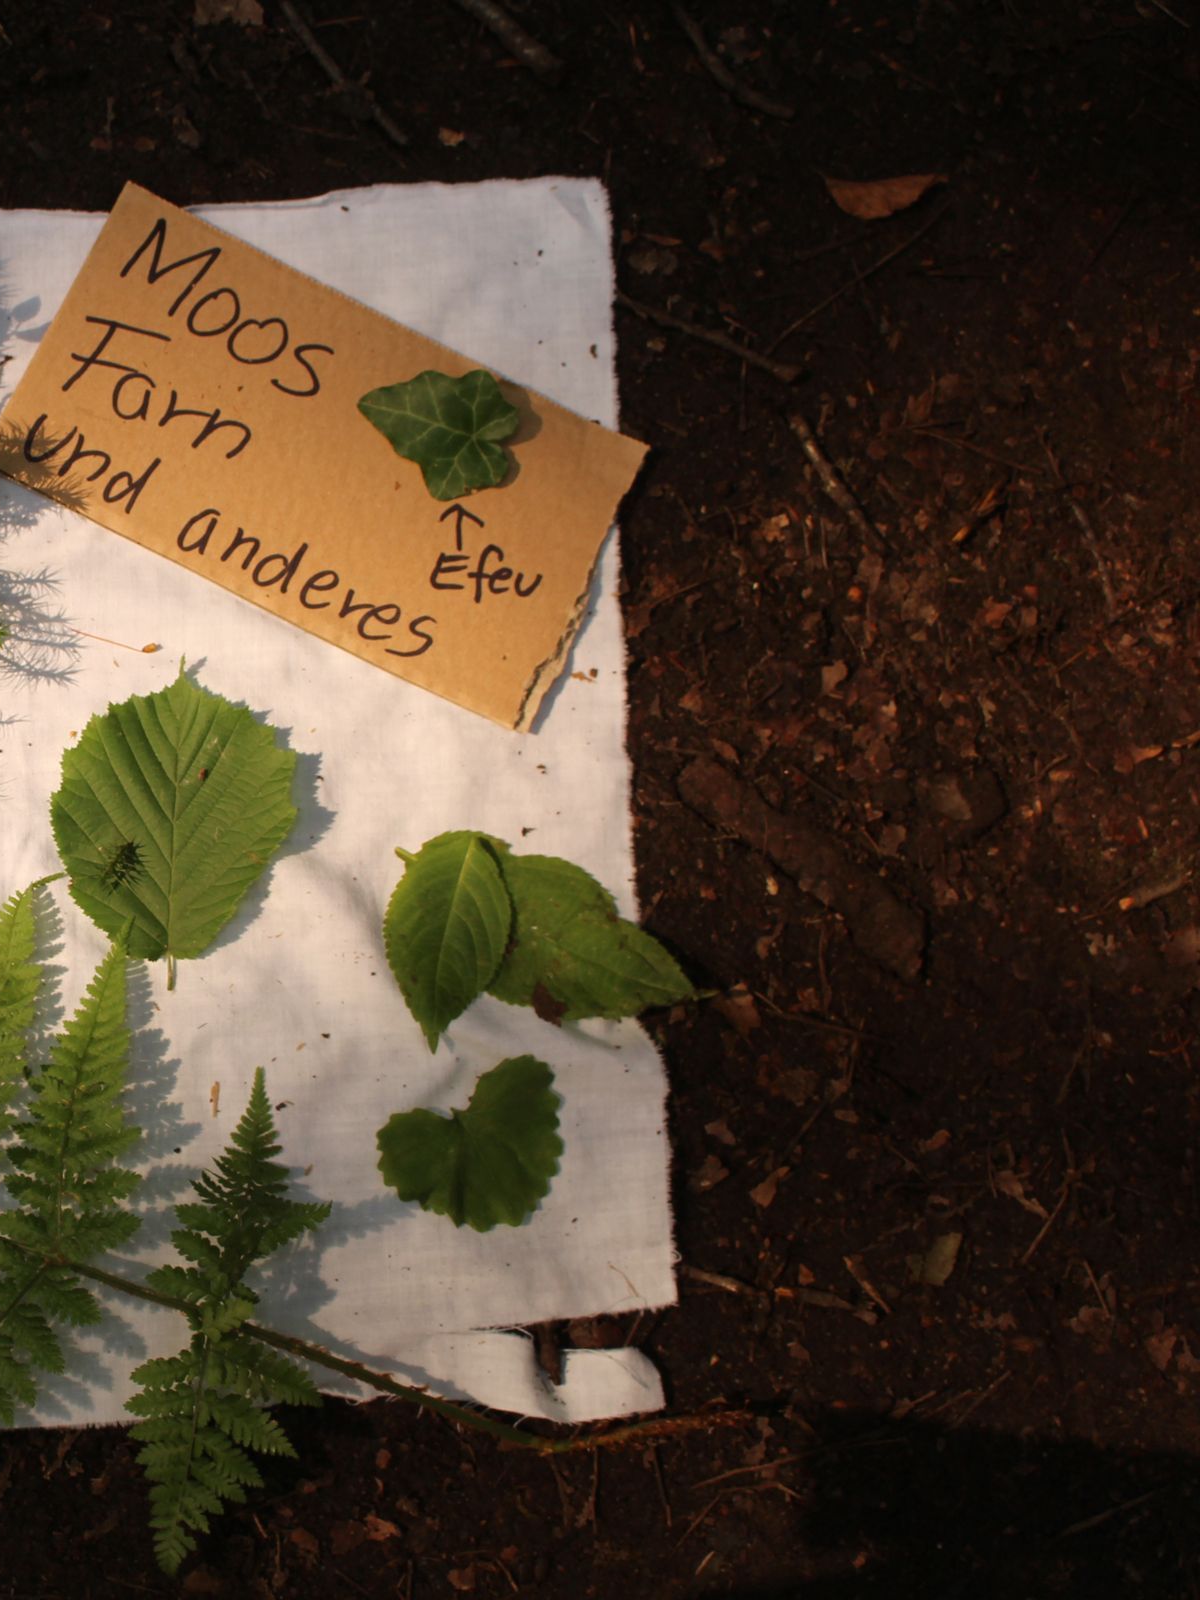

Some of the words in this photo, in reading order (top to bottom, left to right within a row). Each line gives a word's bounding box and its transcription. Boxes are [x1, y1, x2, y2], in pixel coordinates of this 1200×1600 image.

[120, 217, 335, 397] Moos
[61, 315, 252, 459] Farn
[176, 508, 438, 658] anderes
[429, 544, 543, 603] Efeu
